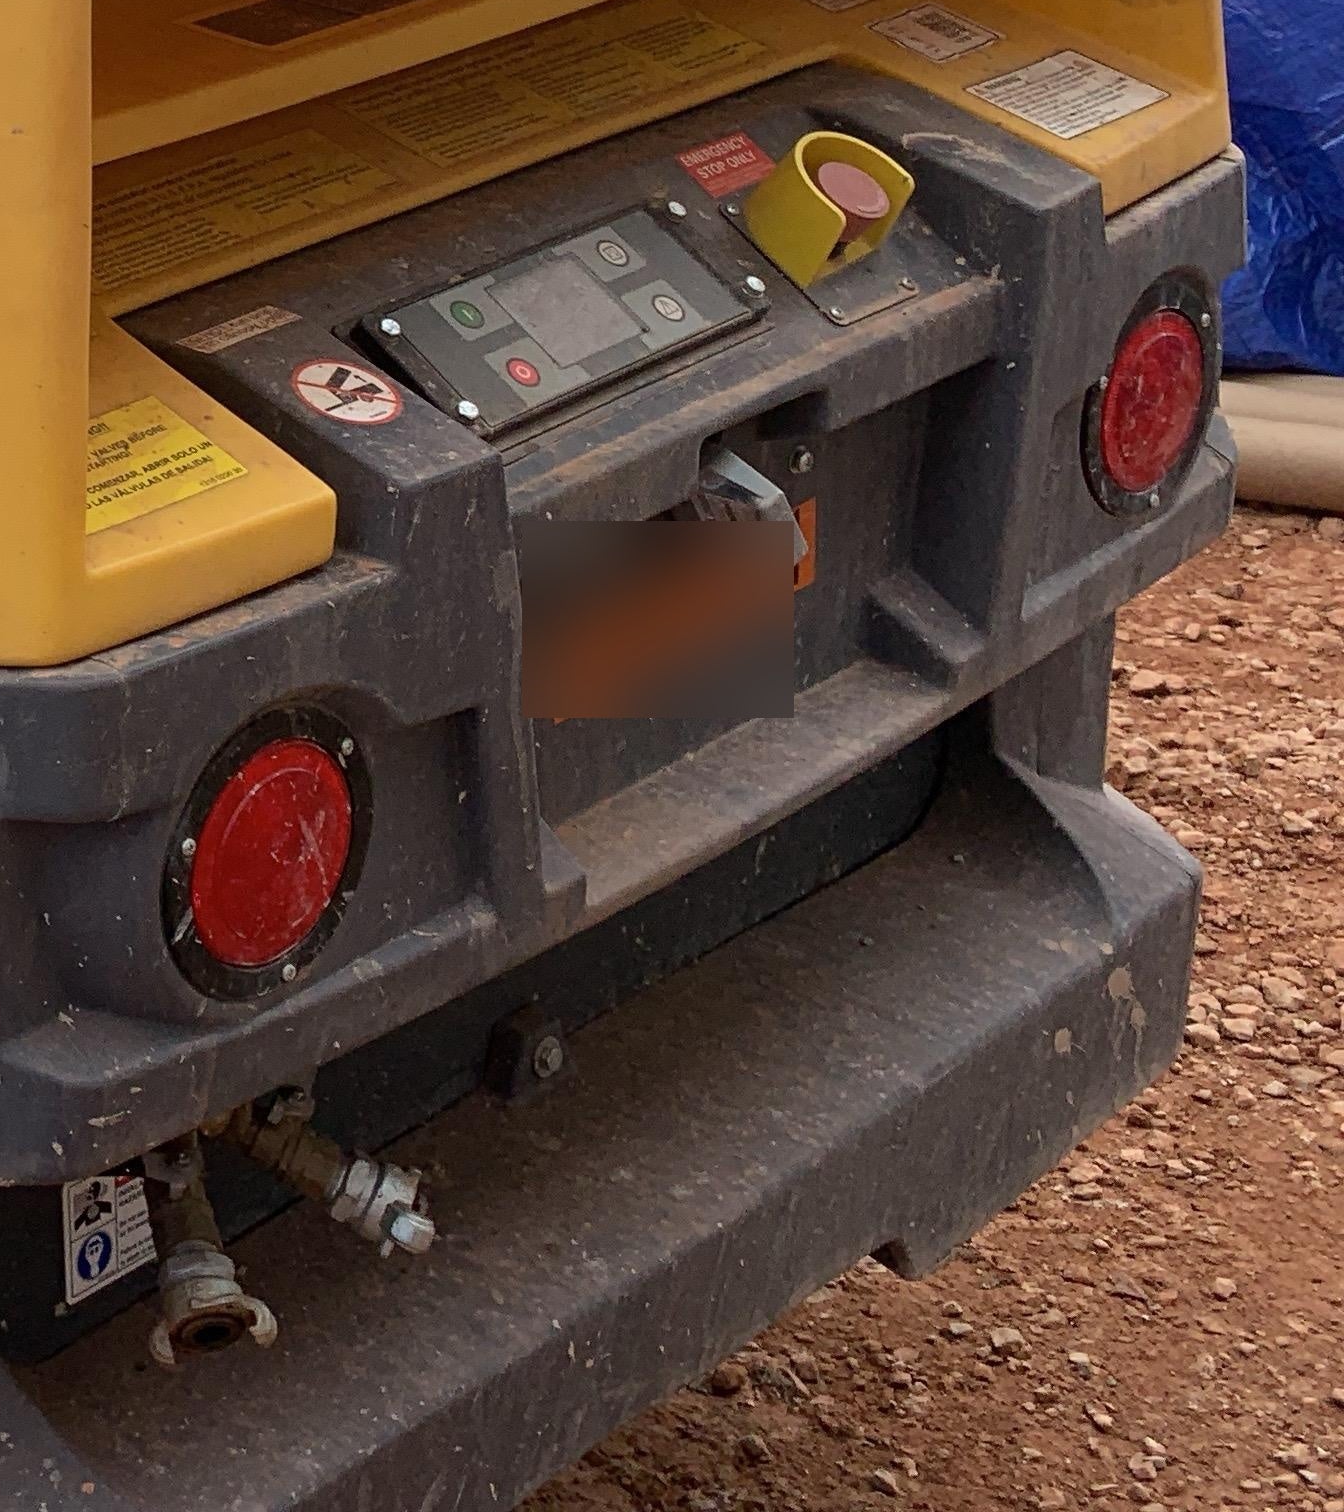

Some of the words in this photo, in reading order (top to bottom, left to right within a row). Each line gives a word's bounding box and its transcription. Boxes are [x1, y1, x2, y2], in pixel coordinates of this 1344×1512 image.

[679, 134, 747, 168] EMERGENCY
[696, 161, 726, 180] STOP
[726, 149, 757, 169] ONLY
[90, 439, 129, 458] VALVES
[127, 423, 168, 444] BEFORE
[142, 456, 173, 474] ABRIR
[171, 445, 199, 461] SOLO
[197, 440, 214, 450] UN
[90, 494, 113, 507] LAS
[160, 469, 177, 480] DE
